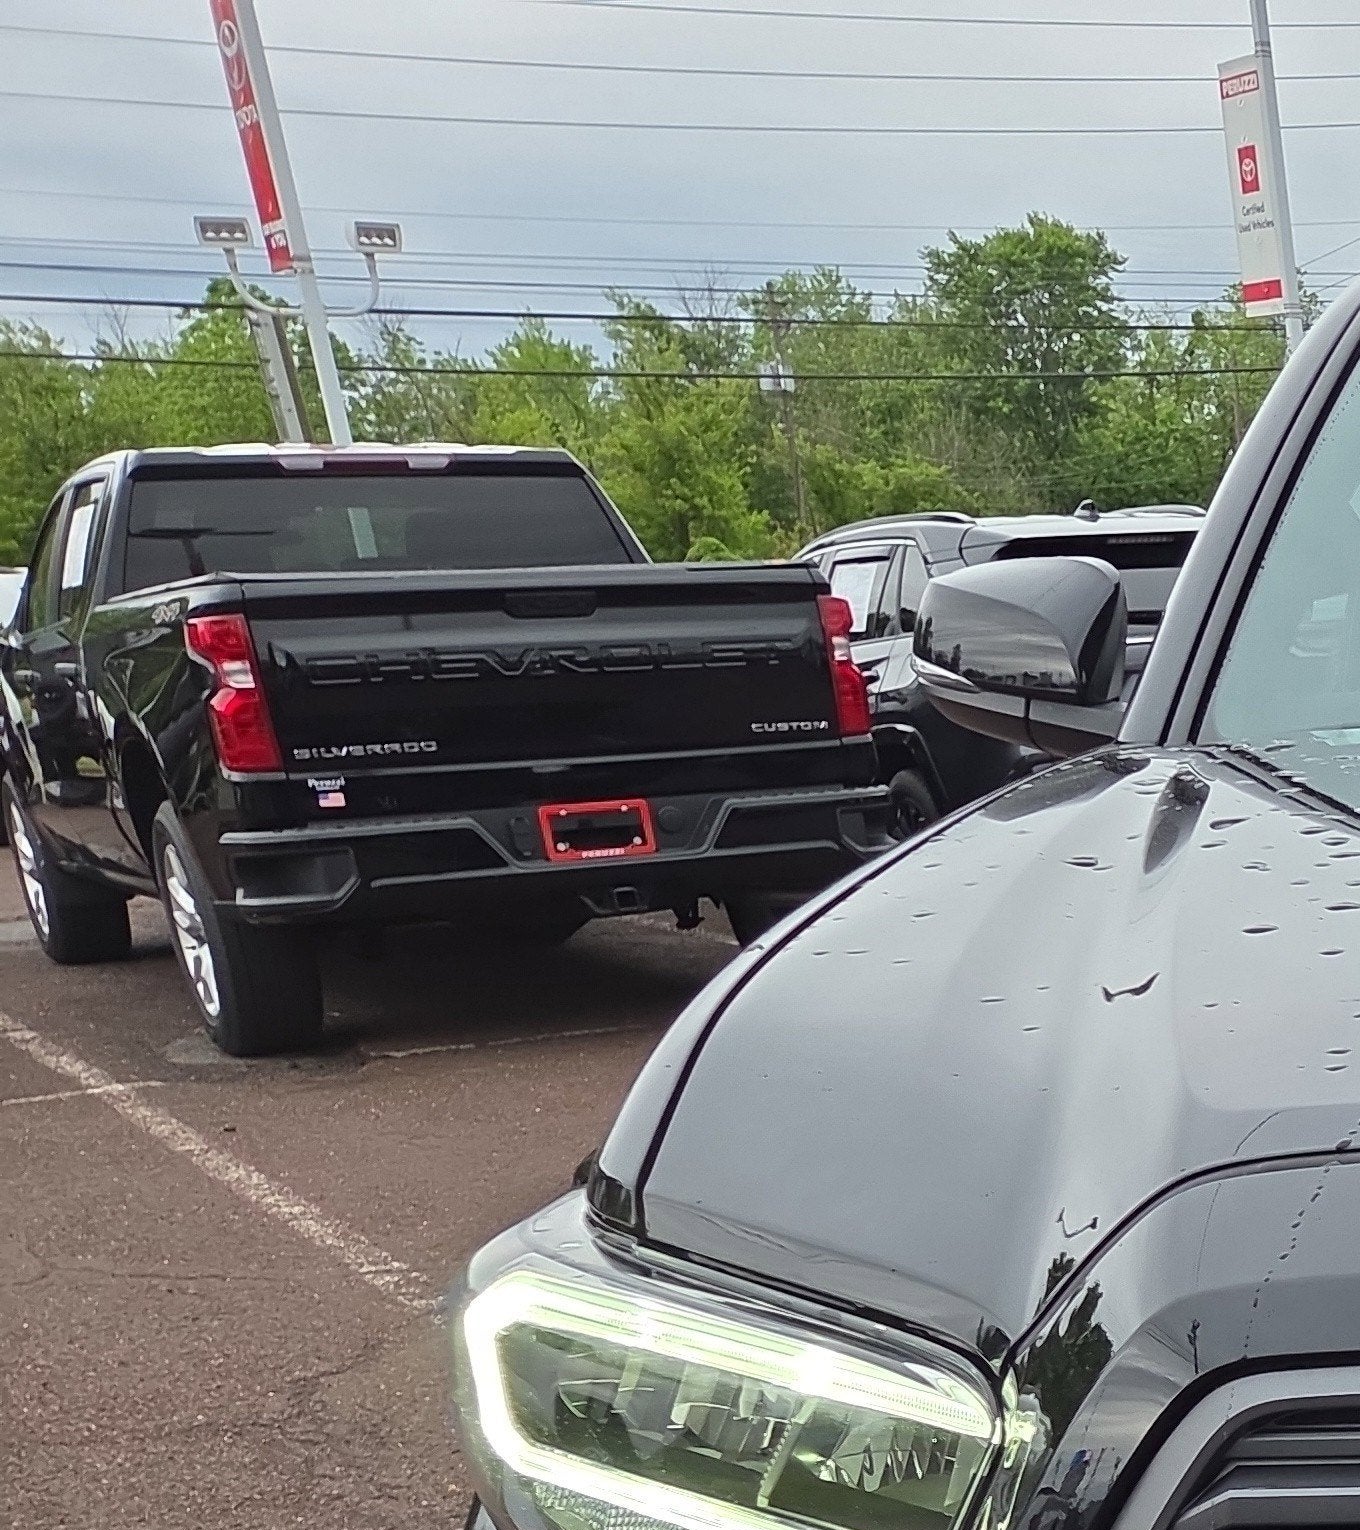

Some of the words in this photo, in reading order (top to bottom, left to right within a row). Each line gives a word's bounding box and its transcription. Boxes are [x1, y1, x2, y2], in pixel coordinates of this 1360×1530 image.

[305, 639, 793, 686] CHEVROLET
[751, 720, 829, 733] CUSTOM
[293, 740, 438, 760] SILVERADO
